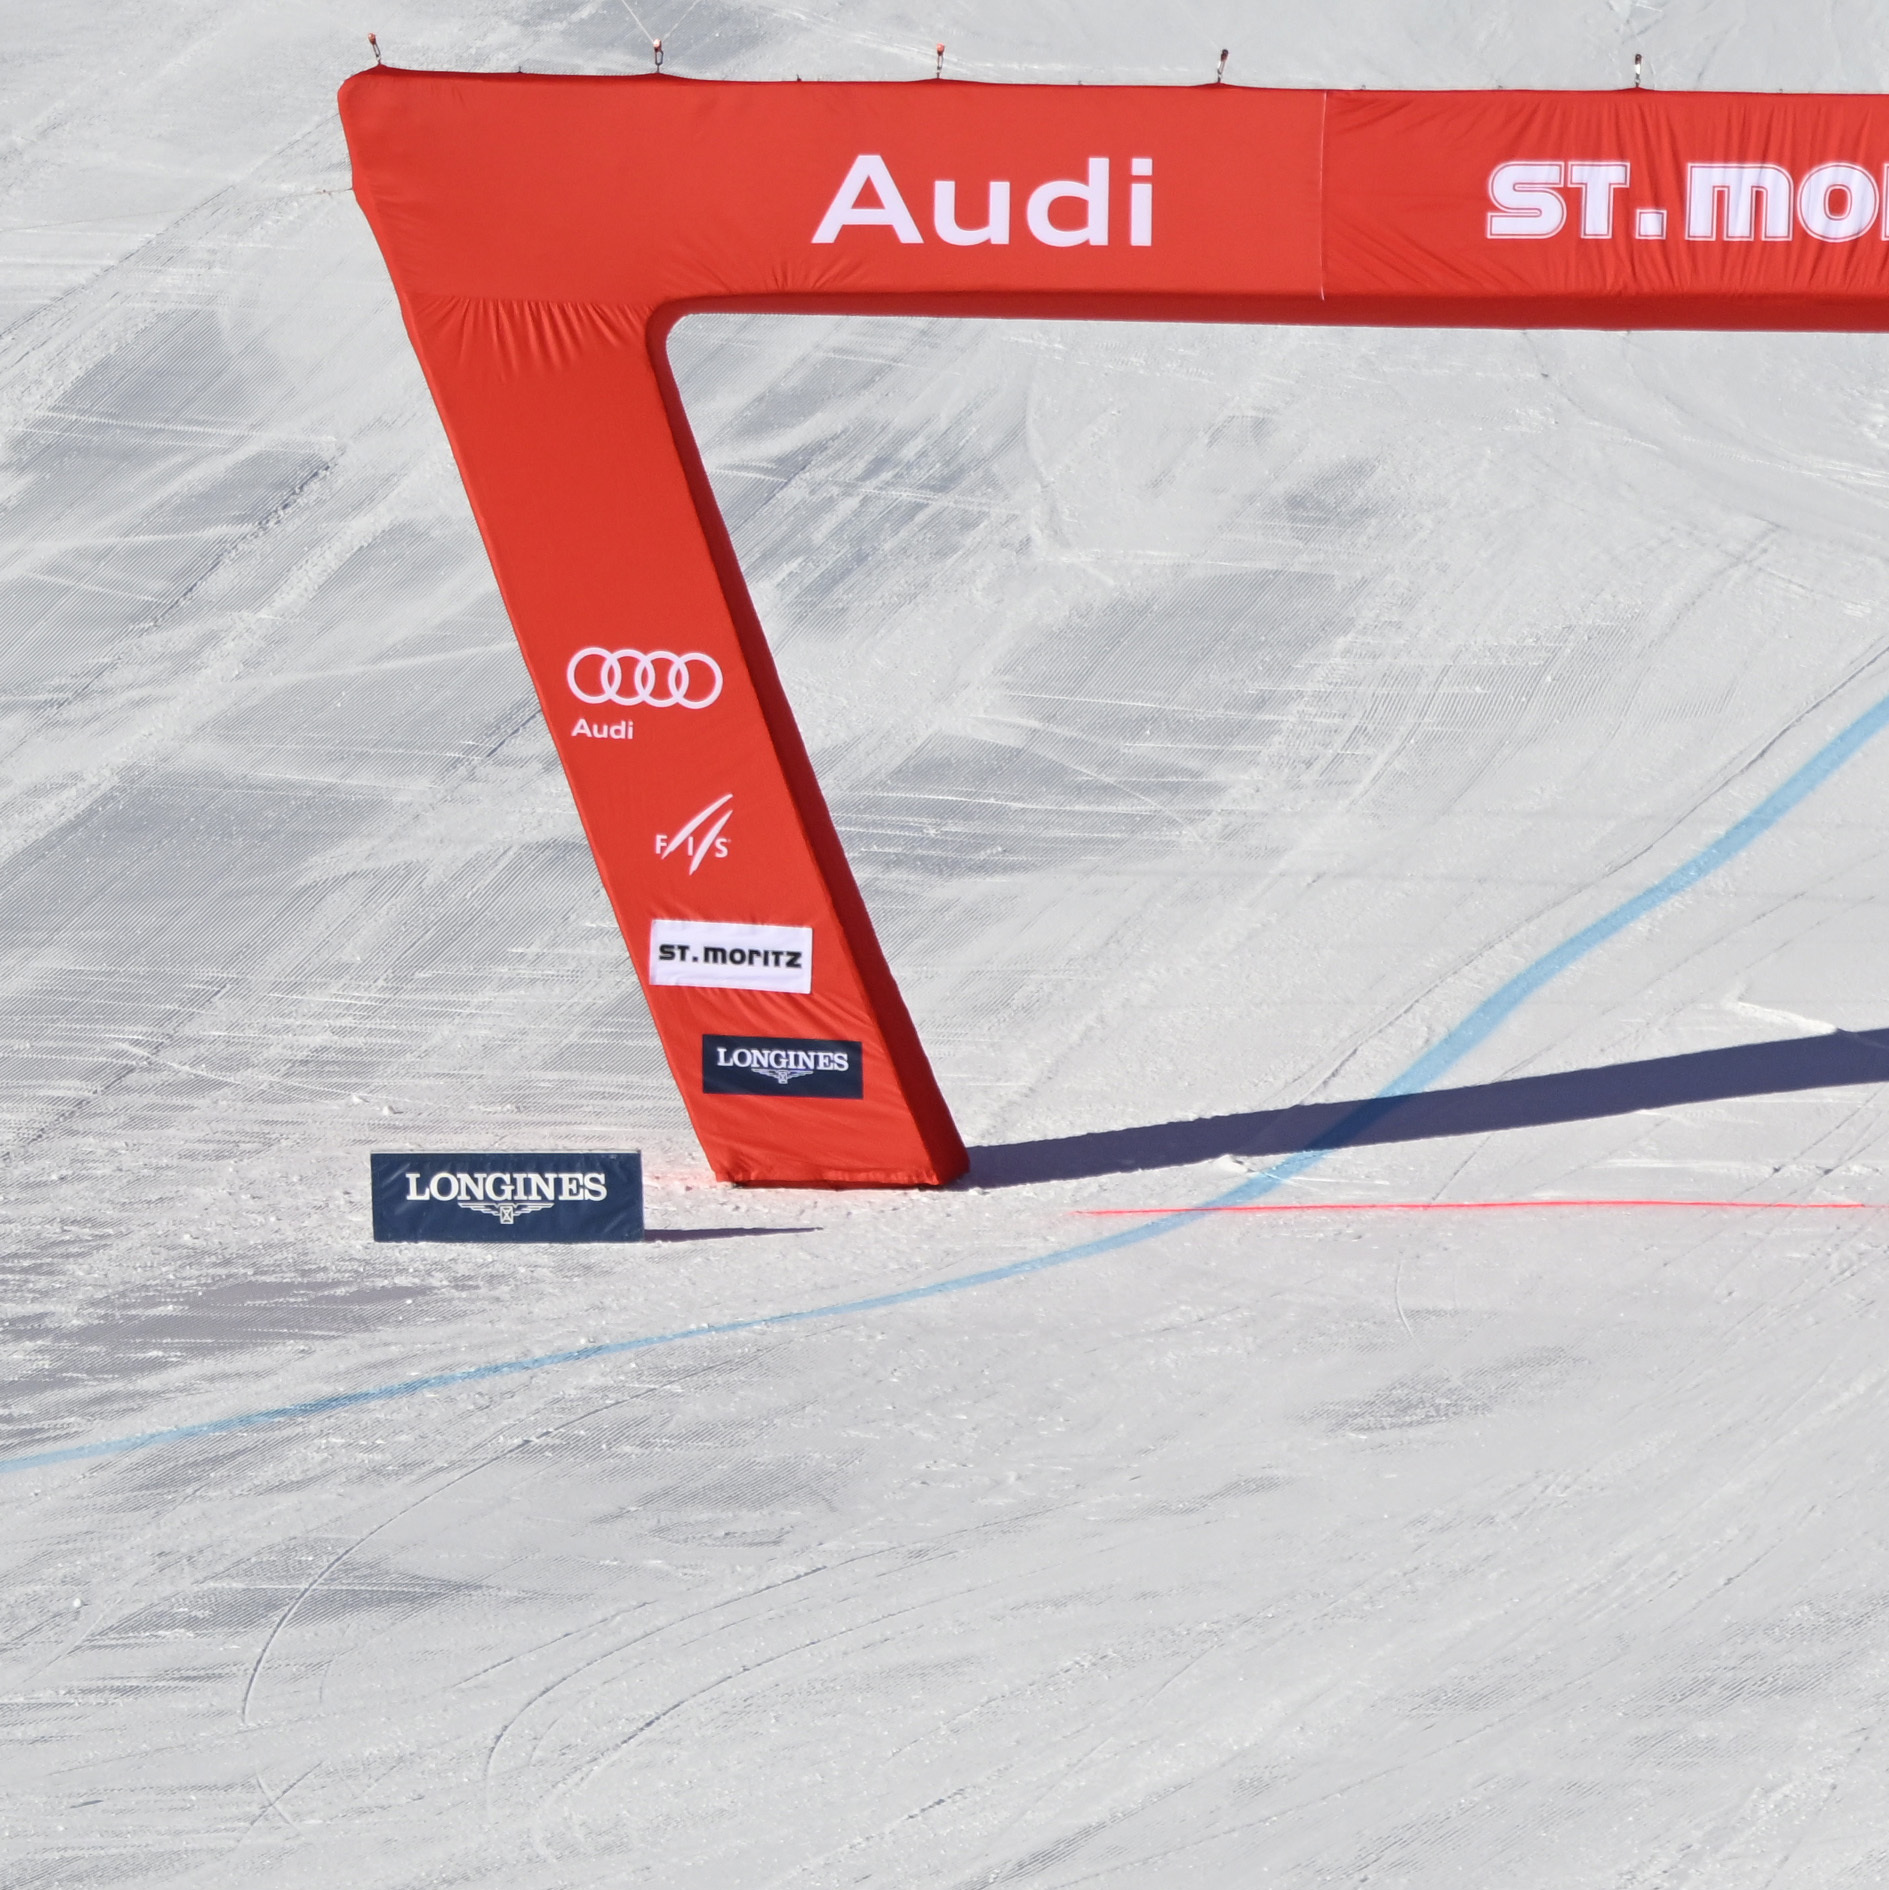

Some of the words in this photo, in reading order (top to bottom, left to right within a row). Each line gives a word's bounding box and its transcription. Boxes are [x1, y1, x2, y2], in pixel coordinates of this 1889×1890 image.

[812, 155, 1152, 247] Audi
[571, 719, 634, 740] Audi
[717, 1048, 849, 1072] LONGINES
[405, 1172, 608, 1202] LONGINES
